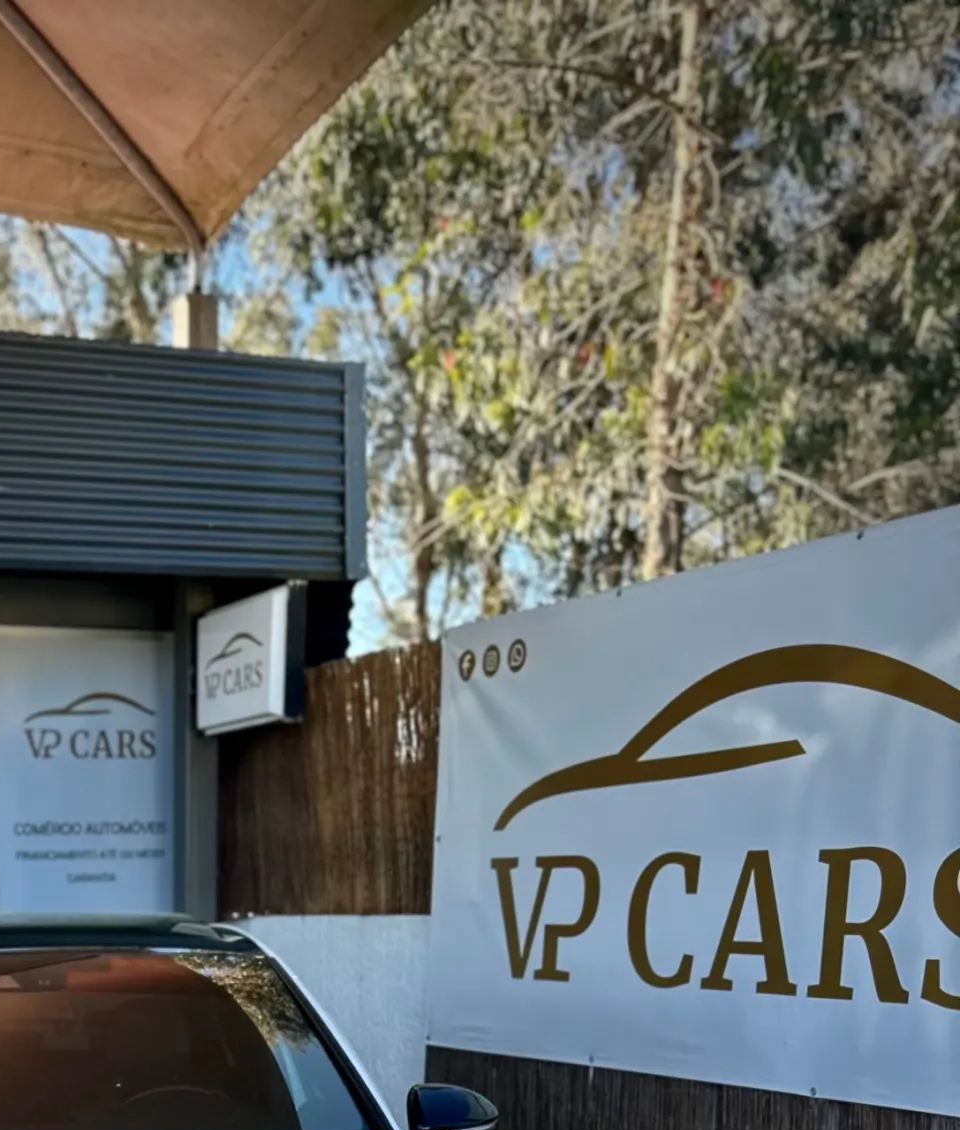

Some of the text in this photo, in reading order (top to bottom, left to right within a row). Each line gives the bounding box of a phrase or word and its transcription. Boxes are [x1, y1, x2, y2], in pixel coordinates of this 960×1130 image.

[222, 660, 263, 696] CARS
[24, 728, 157, 760] VP CARS
[490, 854, 601, 982] VP
